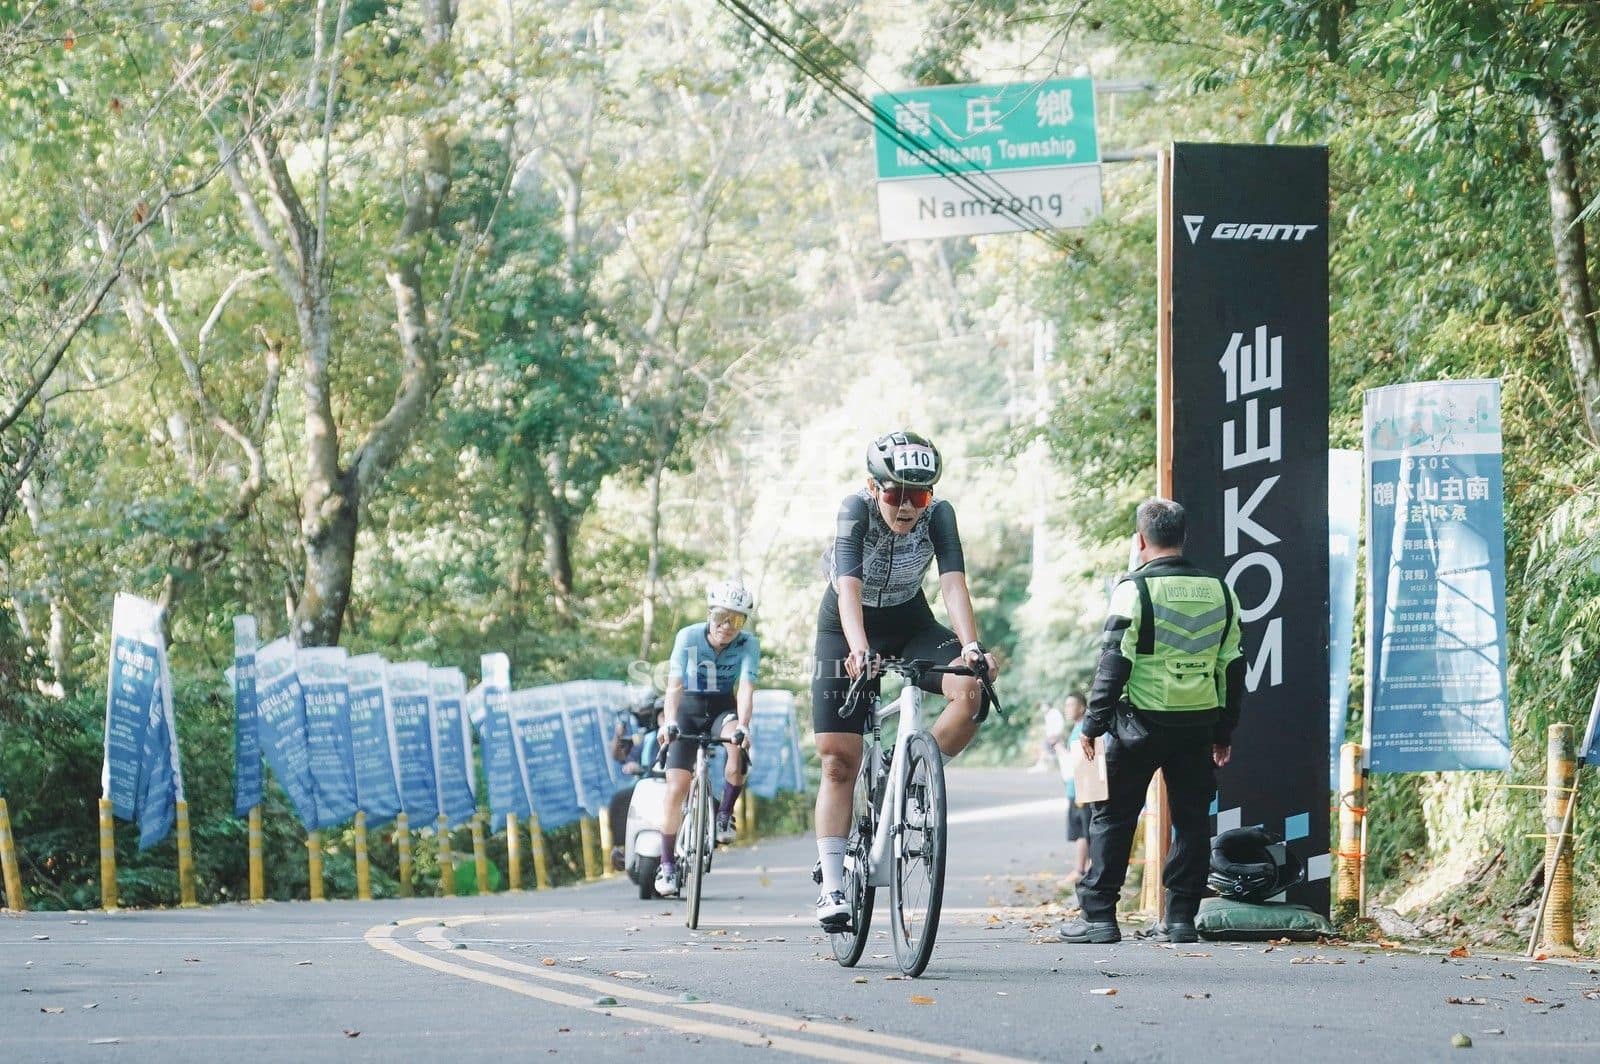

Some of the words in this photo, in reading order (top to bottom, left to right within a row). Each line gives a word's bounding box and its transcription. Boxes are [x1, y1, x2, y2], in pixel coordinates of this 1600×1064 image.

[893, 88, 1075, 137] 南庄鄉
[997, 135, 1077, 160] Township
[918, 192, 1063, 221] Namzong
[1211, 223, 1319, 241] GIANT
[900, 451, 930, 468] 110
